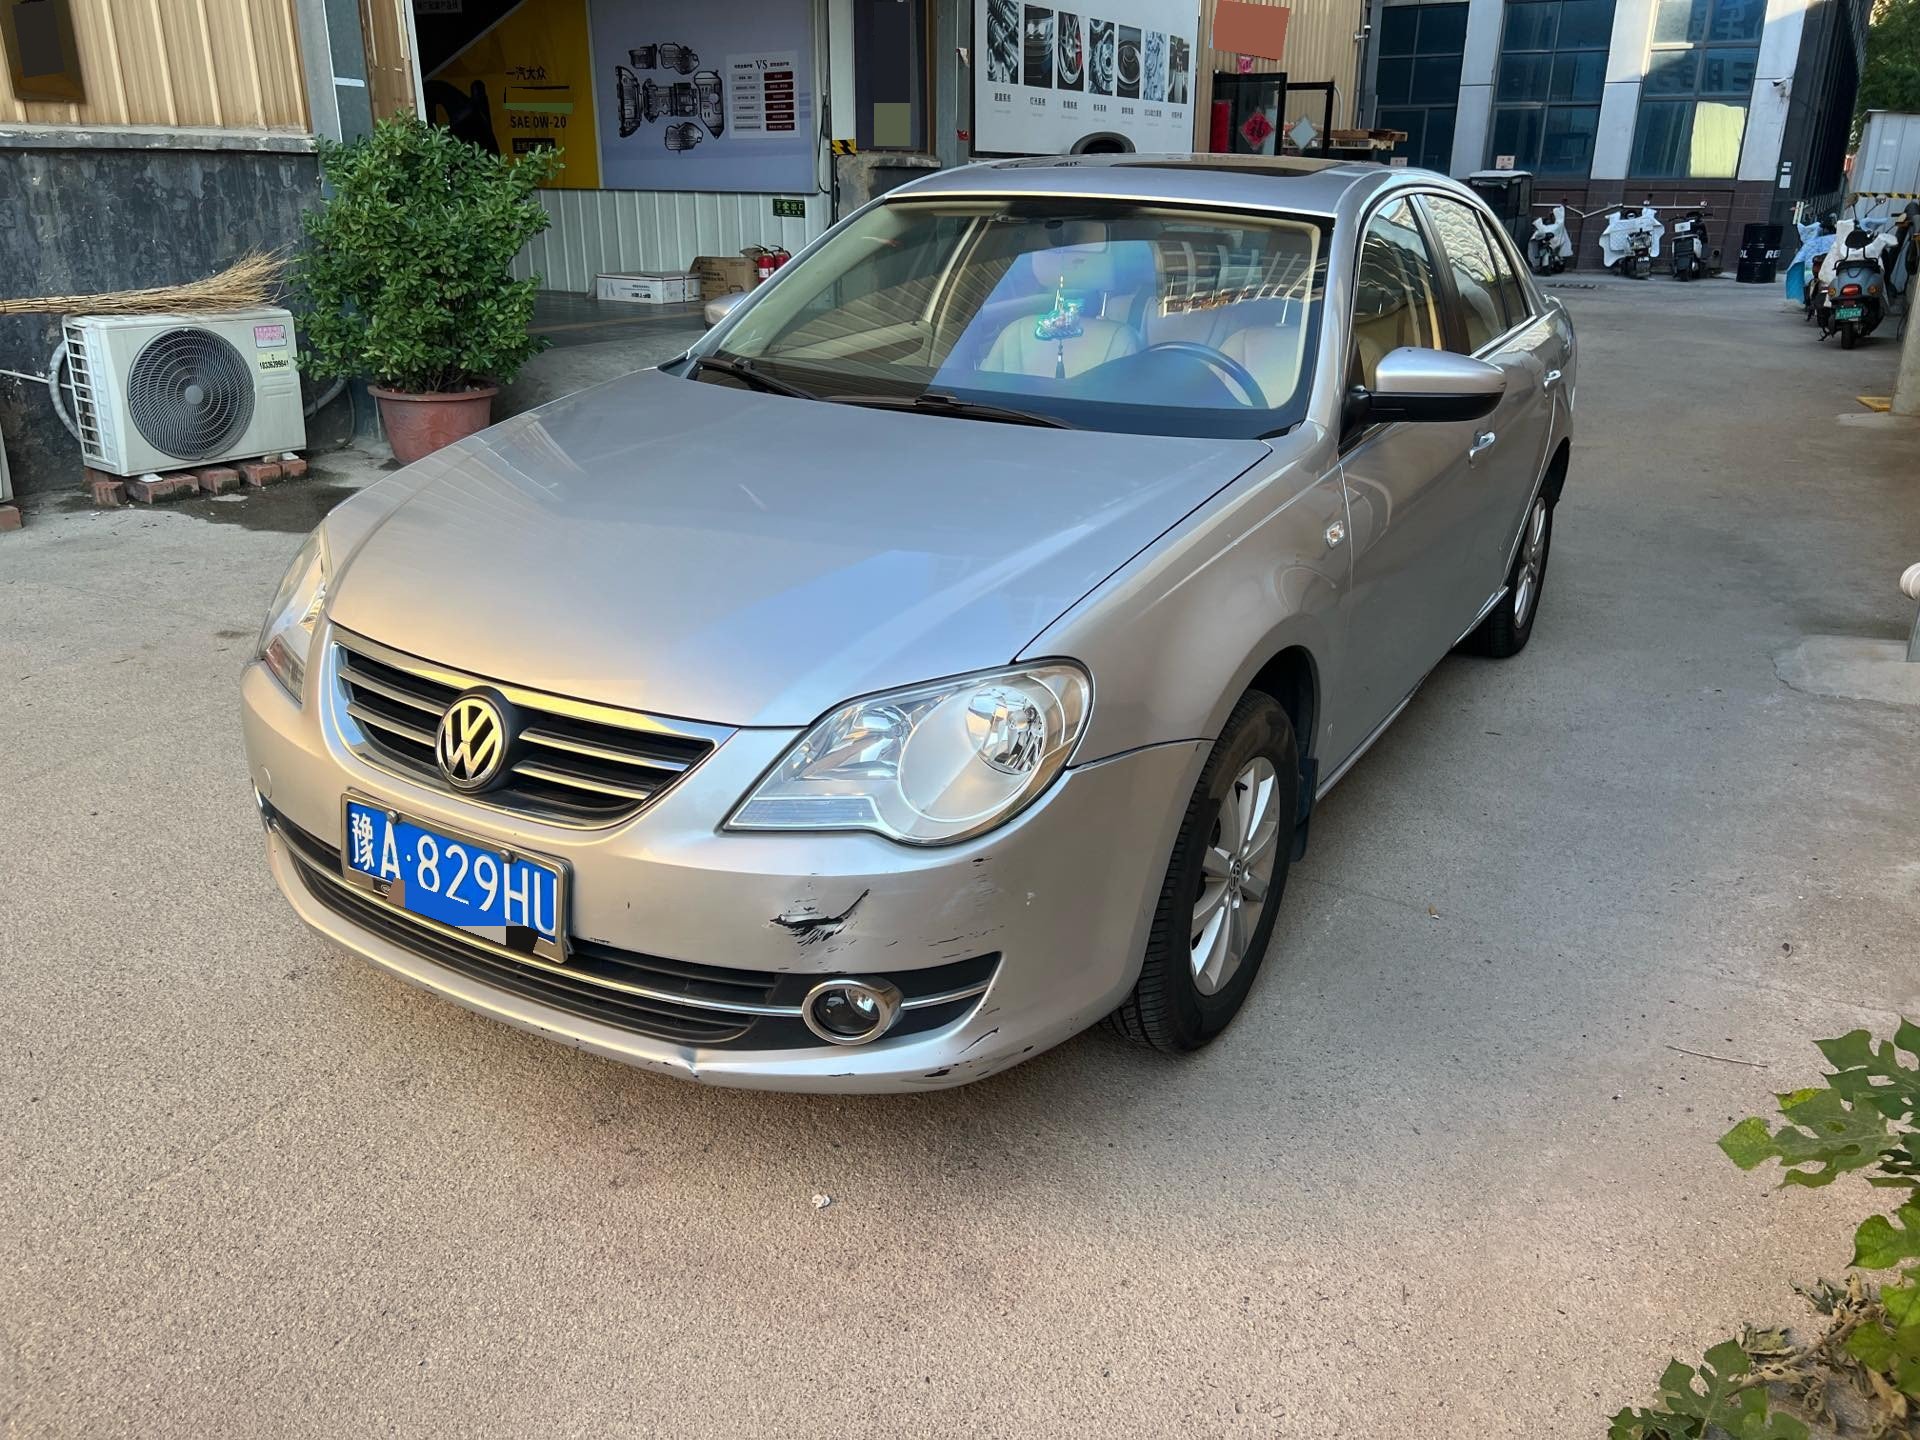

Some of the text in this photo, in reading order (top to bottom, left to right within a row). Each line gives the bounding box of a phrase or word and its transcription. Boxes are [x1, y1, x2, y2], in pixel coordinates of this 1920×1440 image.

[755, 60, 768, 70] VS
[505, 65, 546, 80] 一汽大众
[511, 114, 567, 128] SAE 0W-20
